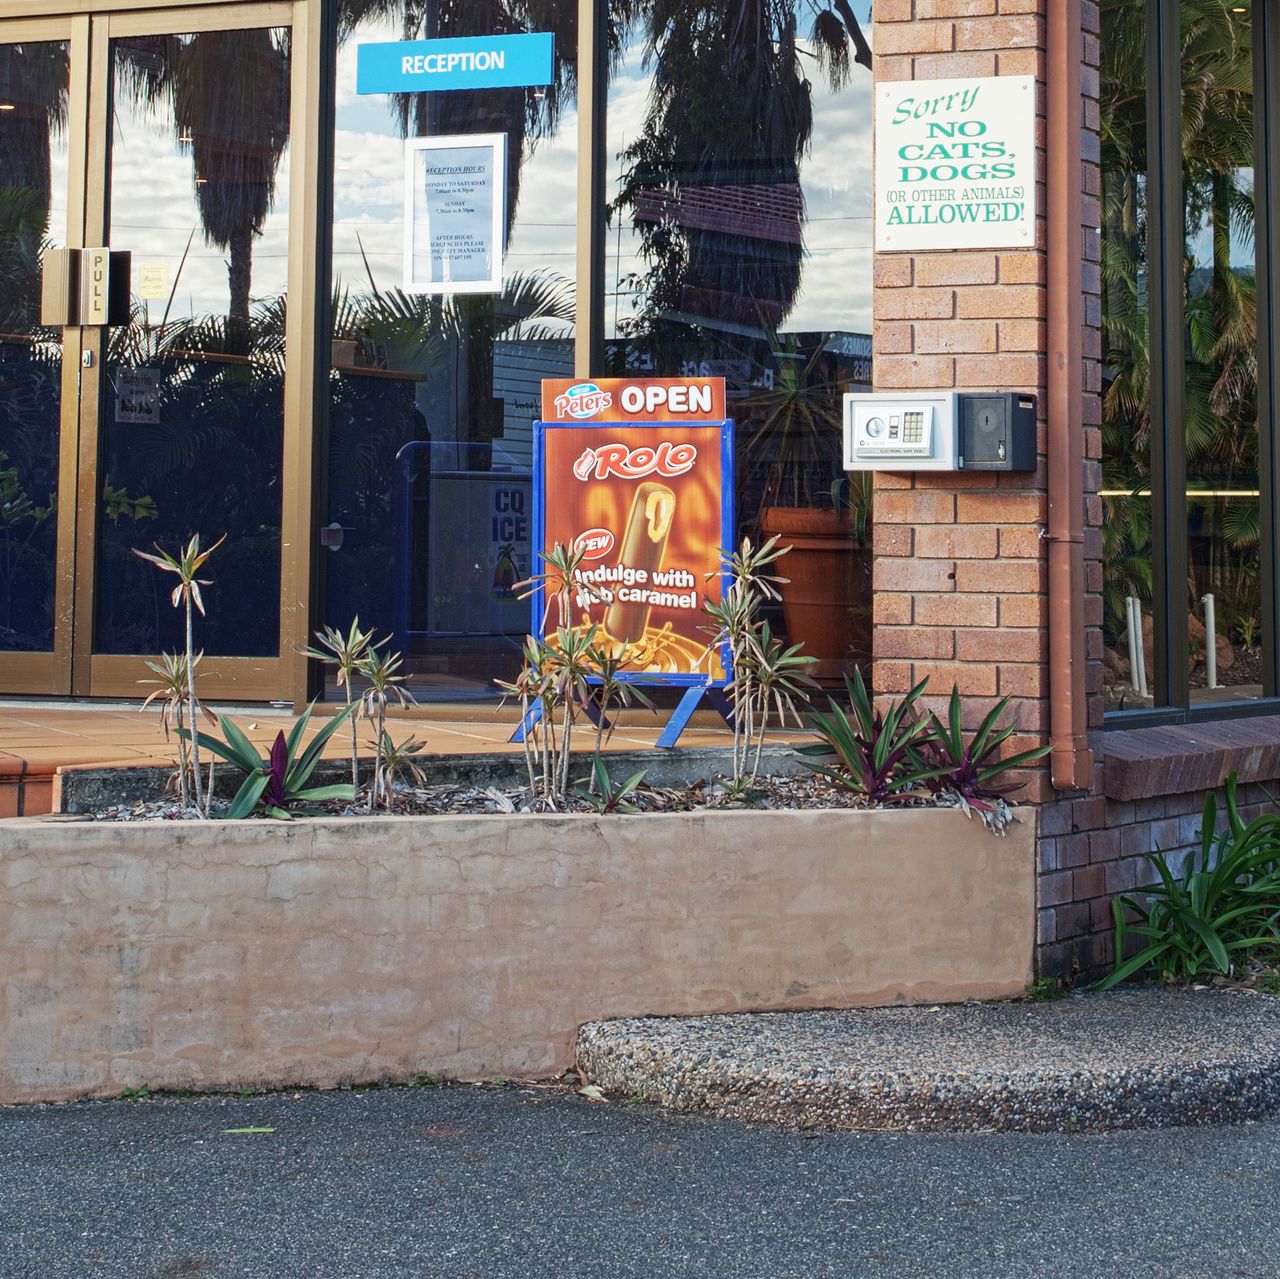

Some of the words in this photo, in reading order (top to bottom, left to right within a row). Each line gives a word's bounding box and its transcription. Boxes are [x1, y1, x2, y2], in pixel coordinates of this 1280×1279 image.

[402, 51, 505, 75] RECEPTION
[892, 85, 980, 125] Sorry
[926, 121, 987, 138] NO
[898, 141, 1016, 161] CATS,
[898, 163, 1016, 182] DOGS
[886, 190, 906, 204] (OR
[911, 188, 956, 202] OTHER
[961, 186, 1024, 200] ANIMALS)
[886, 202, 1025, 225] ALLOWED!
[94, 256, 102, 312] PULL
[554, 391, 613, 419] Peters
[621, 385, 712, 413] OPEN
[595, 442, 697, 479] Rolo
[495, 488, 524, 515] CQ
[492, 517, 527, 542] ICE
[579, 535, 610, 549] NEW
[575, 564, 648, 585] Indulge
[653, 569, 695, 587] with
[618, 586, 697, 608] caramel
